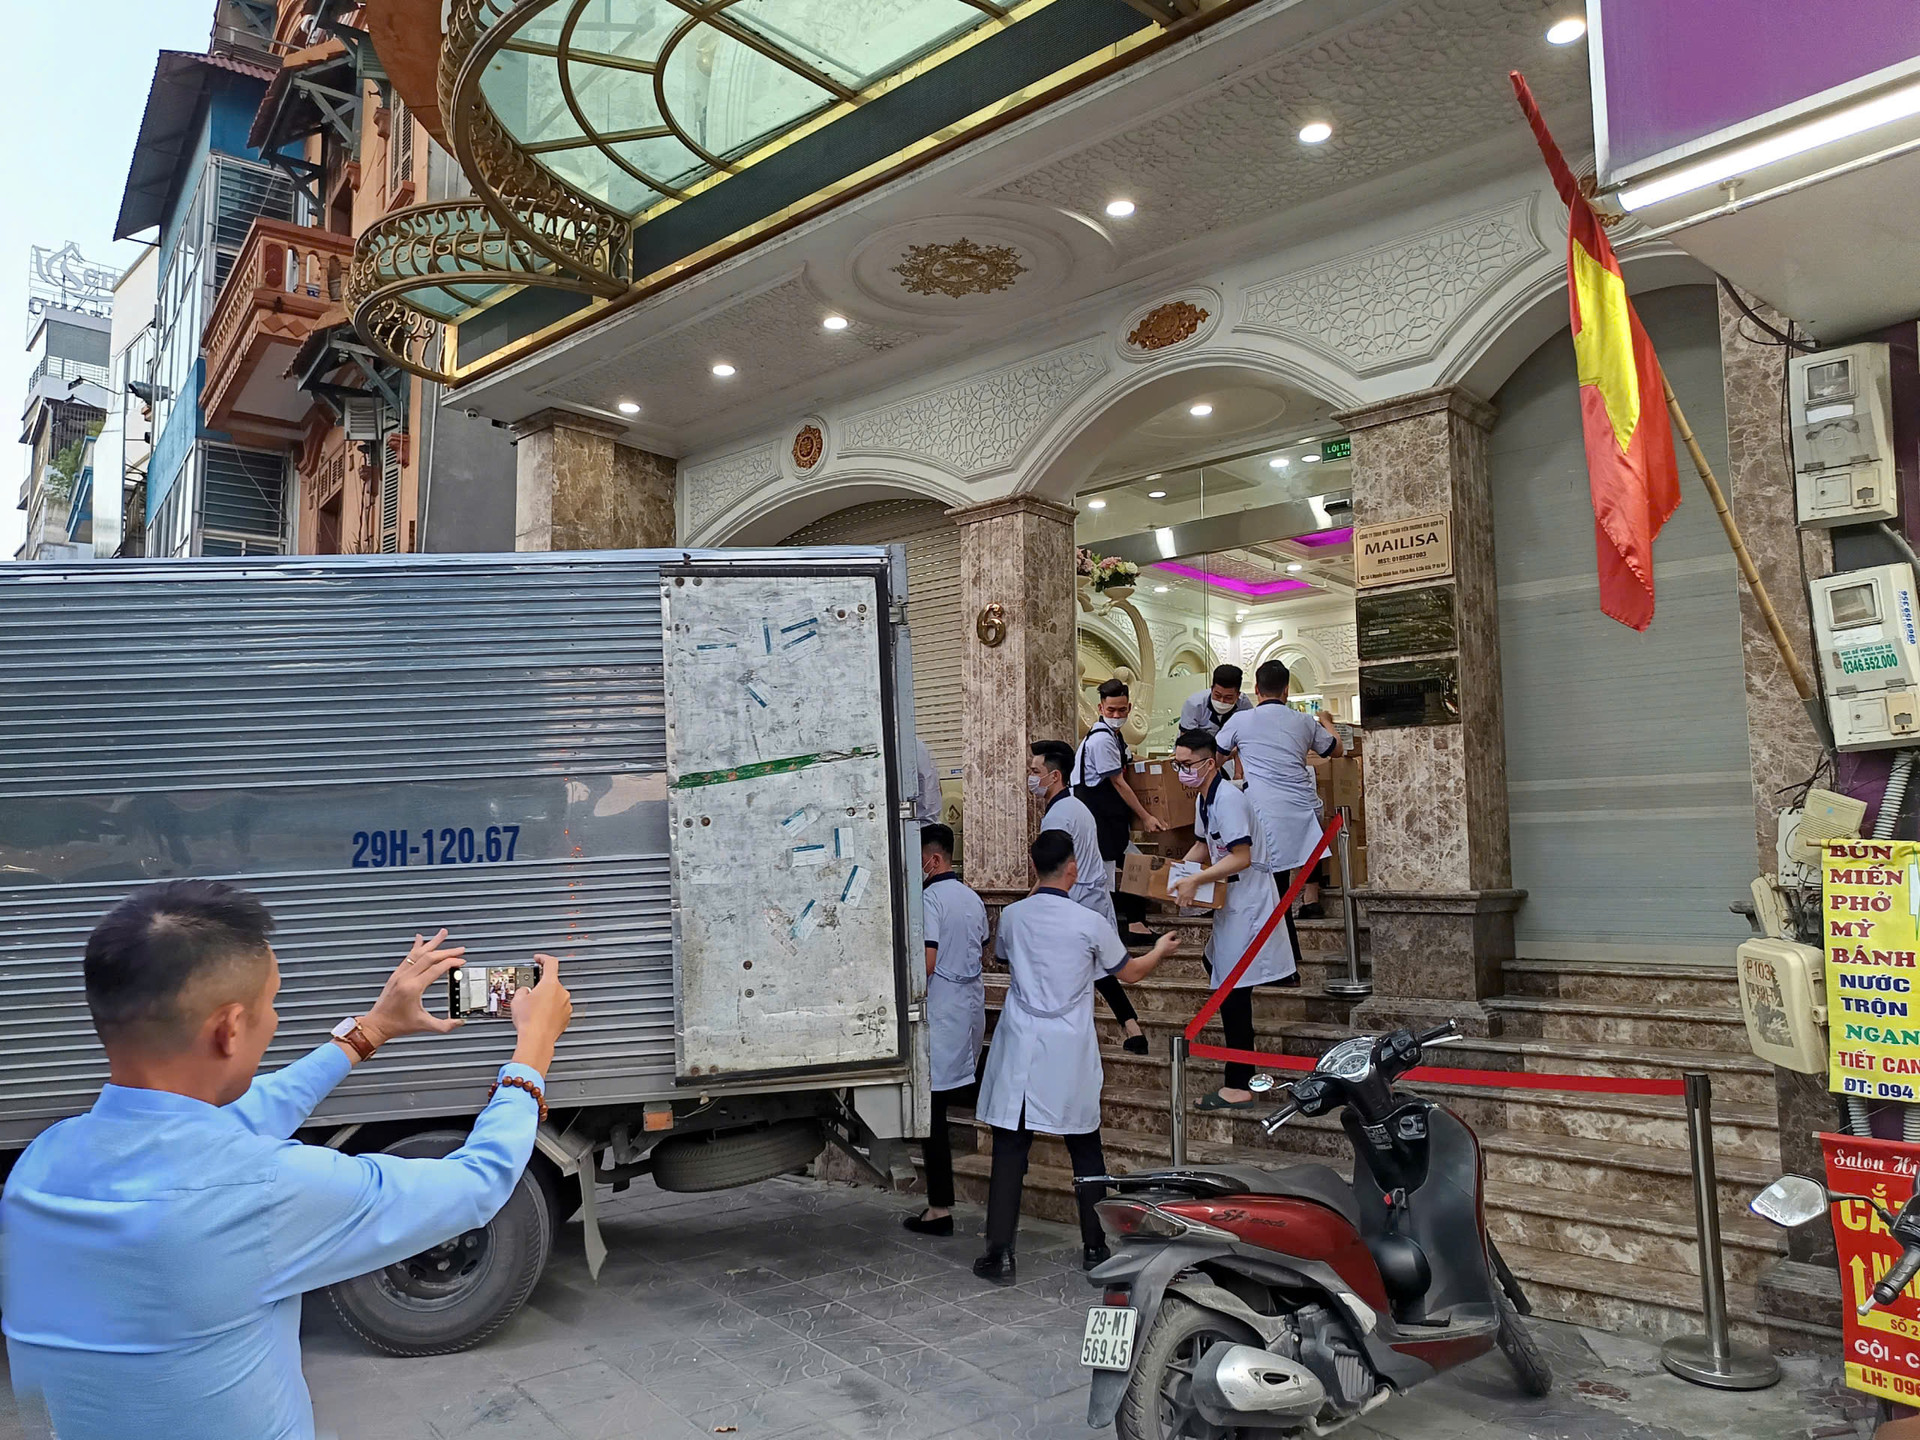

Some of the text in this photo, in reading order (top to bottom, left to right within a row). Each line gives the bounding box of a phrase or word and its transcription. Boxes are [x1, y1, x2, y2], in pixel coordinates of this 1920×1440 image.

[1365, 532, 1439, 555] MAILISA
[977, 602, 1006, 648] 6
[1843, 653, 1898, 675] 0346.552.000
[352, 826, 520, 867] 29H-120.67
[1829, 841, 1893, 860] BÚN
[1829, 863, 1904, 886] MIẾN
[1829, 890, 1892, 912] PHỞ
[1830, 918, 1876, 938] MỲ
[1831, 945, 1916, 968] BÁNH
[1840, 974, 1910, 993] NƯỚC
[1840, 997, 1908, 1018] TRỘN
[1845, 1024, 1920, 1046] NGAN
[1838, 1049, 1876, 1070] TIẾT
[1844, 1077, 1914, 1099] ĐT: 094
[1834, 1148, 1885, 1172] Salon
[1890, 1317, 1907, 1333] SỐ
[1083, 1338, 1129, 1366] 569.45
[1854, 1338, 1889, 1363] GỘI
[1861, 1367, 1888, 1389] LH:
